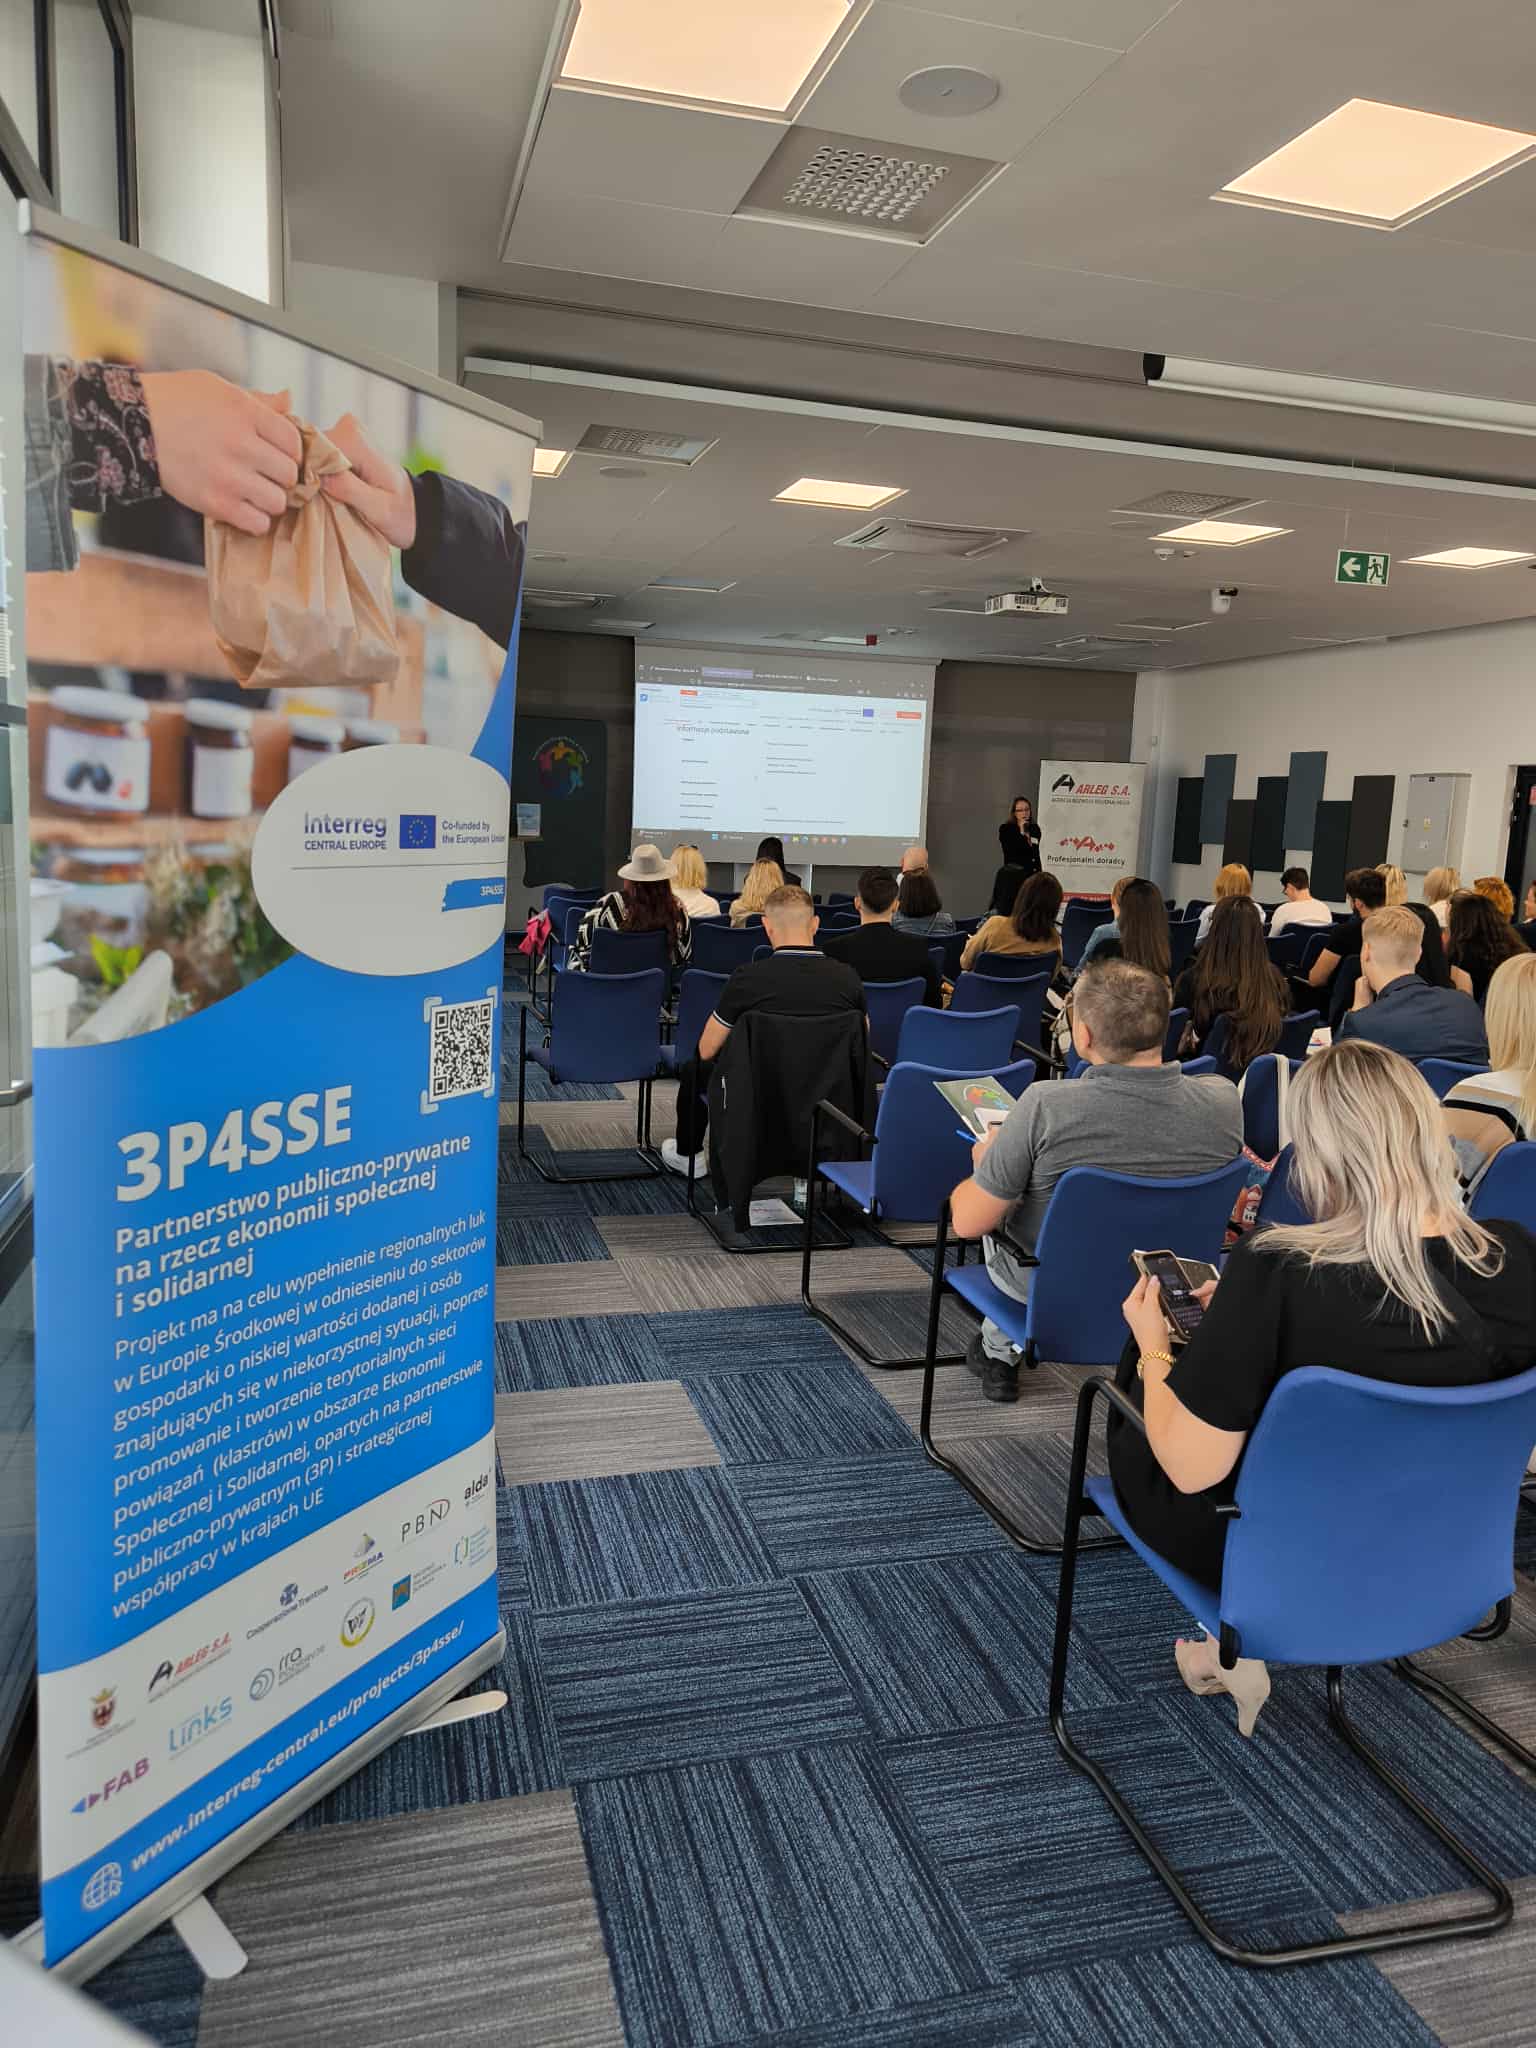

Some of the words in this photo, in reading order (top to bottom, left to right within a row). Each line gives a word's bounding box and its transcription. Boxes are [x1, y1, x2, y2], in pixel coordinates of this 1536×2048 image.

[304, 812, 387, 837] Interreg
[304, 840, 348, 850] CENTRAL
[350, 840, 387, 850] EUROPE
[442, 820, 480, 831] Co-funded
[482, 820, 490, 832] by
[442, 834, 454, 844] the
[456, 834, 490, 844] European
[1075, 784, 1107, 796] ARLEG
[1110, 785, 1131, 796] S.A.
[116, 1085, 353, 1202] 3P4SSE
[116, 1191, 271, 1253] Partnerstwo
[276, 1135, 471, 1209] publiczno-prywatne
[115, 1259, 151, 1286] na
[160, 1235, 221, 1273] rzecz
[227, 1196, 329, 1248] ekonomii
[335, 1165, 437, 1215] społecznej
[115, 1292, 124, 1318] i
[132, 1247, 254, 1313] solidarnej
[115, 1320, 185, 1360] Projekt
[190, 1309, 217, 1332] ma
[222, 1299, 243, 1319] na
[248, 1283, 281, 1308] celu
[285, 1249, 375, 1294] wypełnienie
[380, 1218, 466, 1260] regionalnych
[469, 1209, 486, 1230] luk
[113, 1364, 220, 1432] gospodarki
[224, 1363, 235, 1379] o
[239, 1335, 291, 1372] niskiej
[294, 1312, 358, 1347] wartości
[361, 1285, 419, 1322] dodanej
[430, 1270, 462, 1294] osób
[114, 1374, 133, 1393] w
[139, 1343, 210, 1385] Europie
[214, 1302, 301, 1353] Środkowej
[304, 1299, 318, 1316] w
[321, 1266, 405, 1308] odniesieniu
[409, 1255, 428, 1277] do
[431, 1236, 487, 1269] sektorów
[114, 1391, 233, 1459] znajdujących
[237, 1380, 260, 1402] się
[265, 1372, 279, 1390] w
[282, 1326, 382, 1382] niekorzystnej
[385, 1304, 440, 1339] sytuacji,
[443, 1284, 489, 1318] poprzez
[114, 1425, 231, 1497] promowanie
[245, 1381, 323, 1429] tworzenie
[326, 1334, 425, 1391] terytorialnych
[428, 1321, 457, 1346] sieci
[114, 1464, 204, 1529] powiązań
[213, 1421, 294, 1476] (klastrów)
[297, 1415, 310, 1433] w
[314, 1383, 379, 1423] obszarze
[383, 1351, 446, 1391] Ekonomii
[114, 1490, 213, 1556] Społecznej
[227, 1441, 310, 1497] Solidarnej,
[315, 1408, 380, 1450] opartych
[383, 1399, 400, 1417] na
[404, 1359, 483, 1411] partnerstwie
[114, 1475, 301, 1593] publiczno-prywatnym
[304, 1456, 334, 1486] (3P)
[345, 1406, 433, 1463] strategicznej
[464, 1474, 489, 1500] alda
[112, 1549, 219, 1619] współpracy
[222, 1537, 237, 1556] w
[241, 1503, 299, 1547] krajach
[304, 1486, 325, 1511] UE
[103, 1757, 150, 1801] FAB
[131, 1619, 465, 1872] www.interreg-central.eu/projects/3p4sse/
